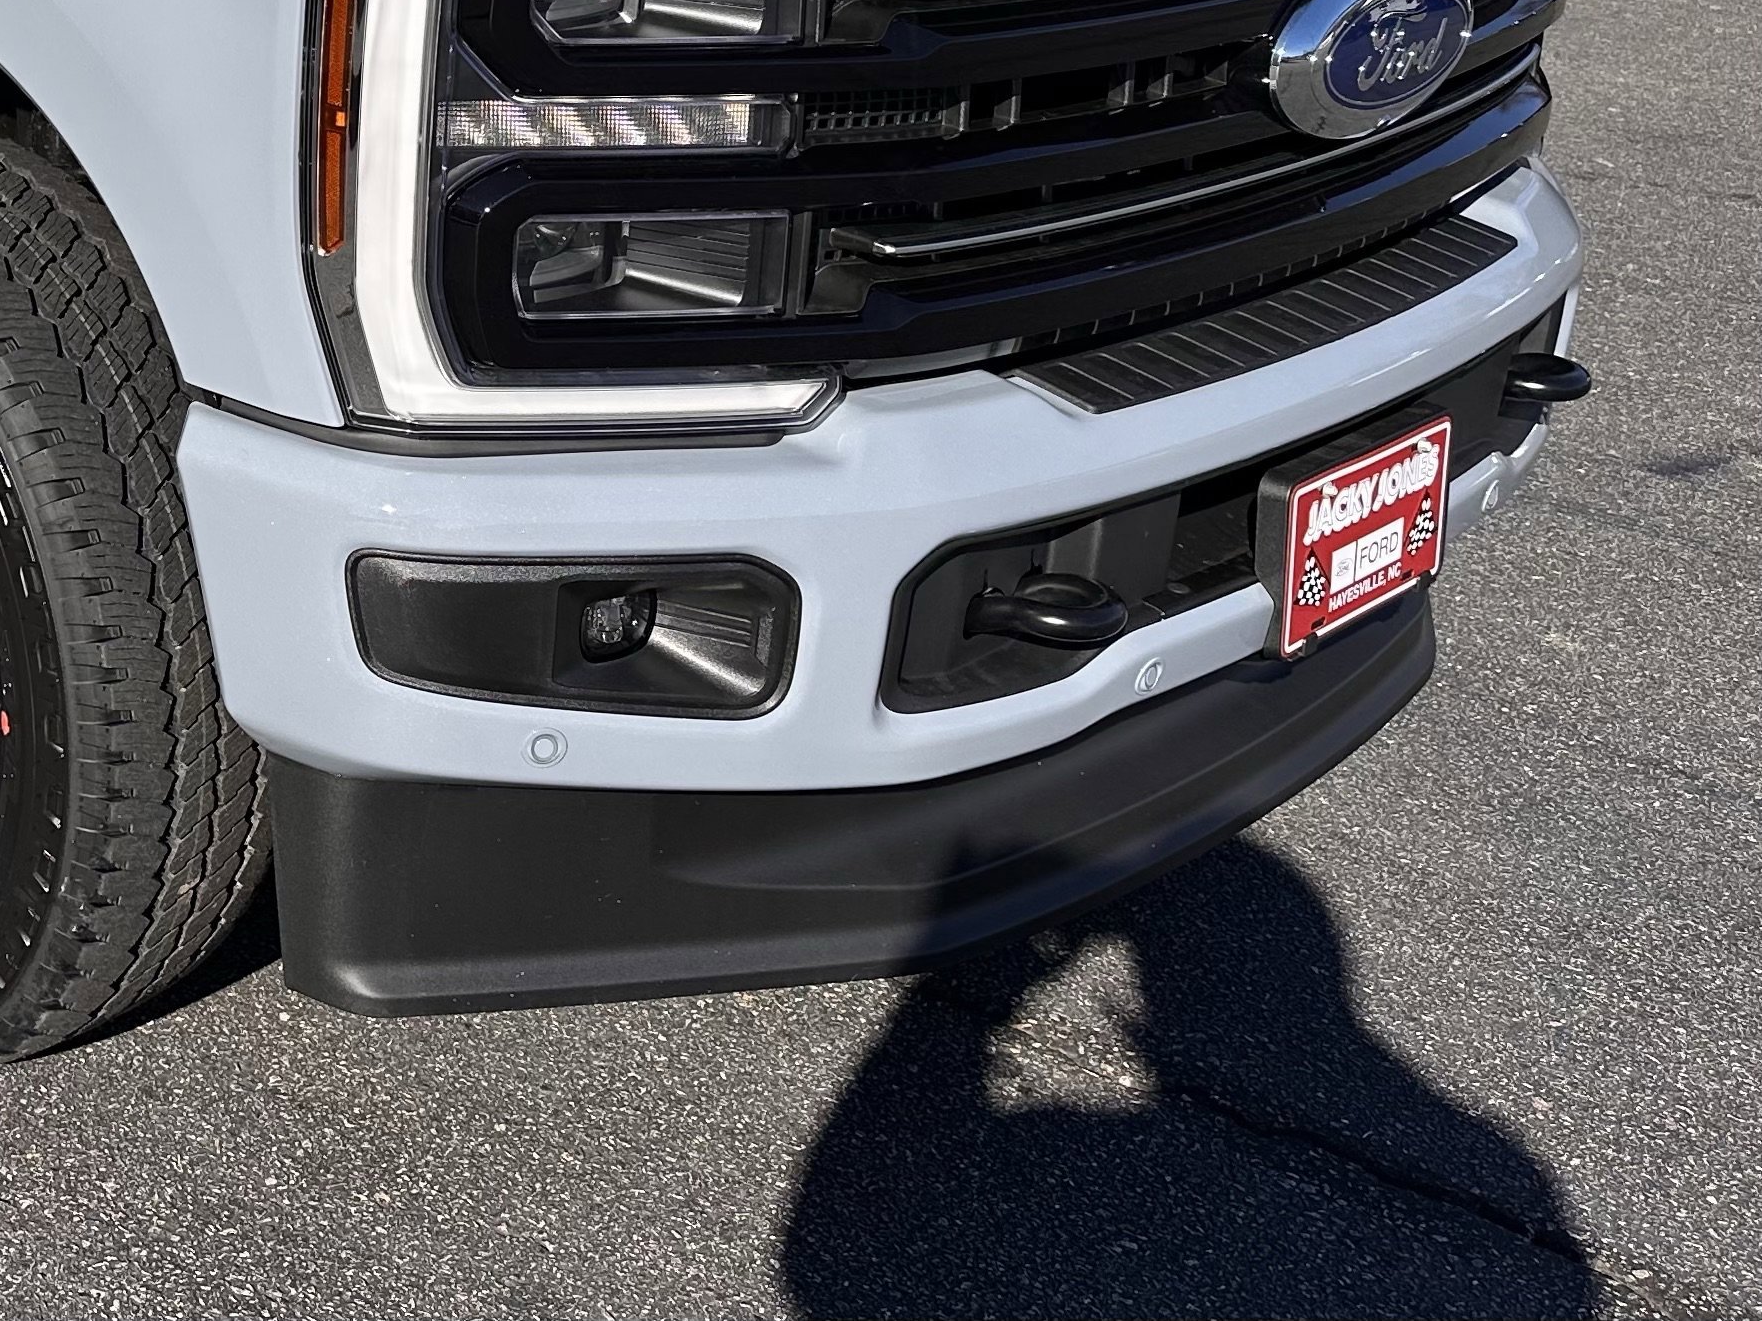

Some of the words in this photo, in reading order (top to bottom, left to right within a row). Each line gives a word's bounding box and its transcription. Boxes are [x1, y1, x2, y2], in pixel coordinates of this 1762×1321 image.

[1356, 8, 1448, 92] Ford
[1303, 473, 1379, 546] JACKY
[1372, 444, 1440, 512] JONES
[1359, 531, 1399, 569] FORD
[1328, 570, 1387, 612] HAYESVILLE,
[1387, 561, 1402, 582] NC
